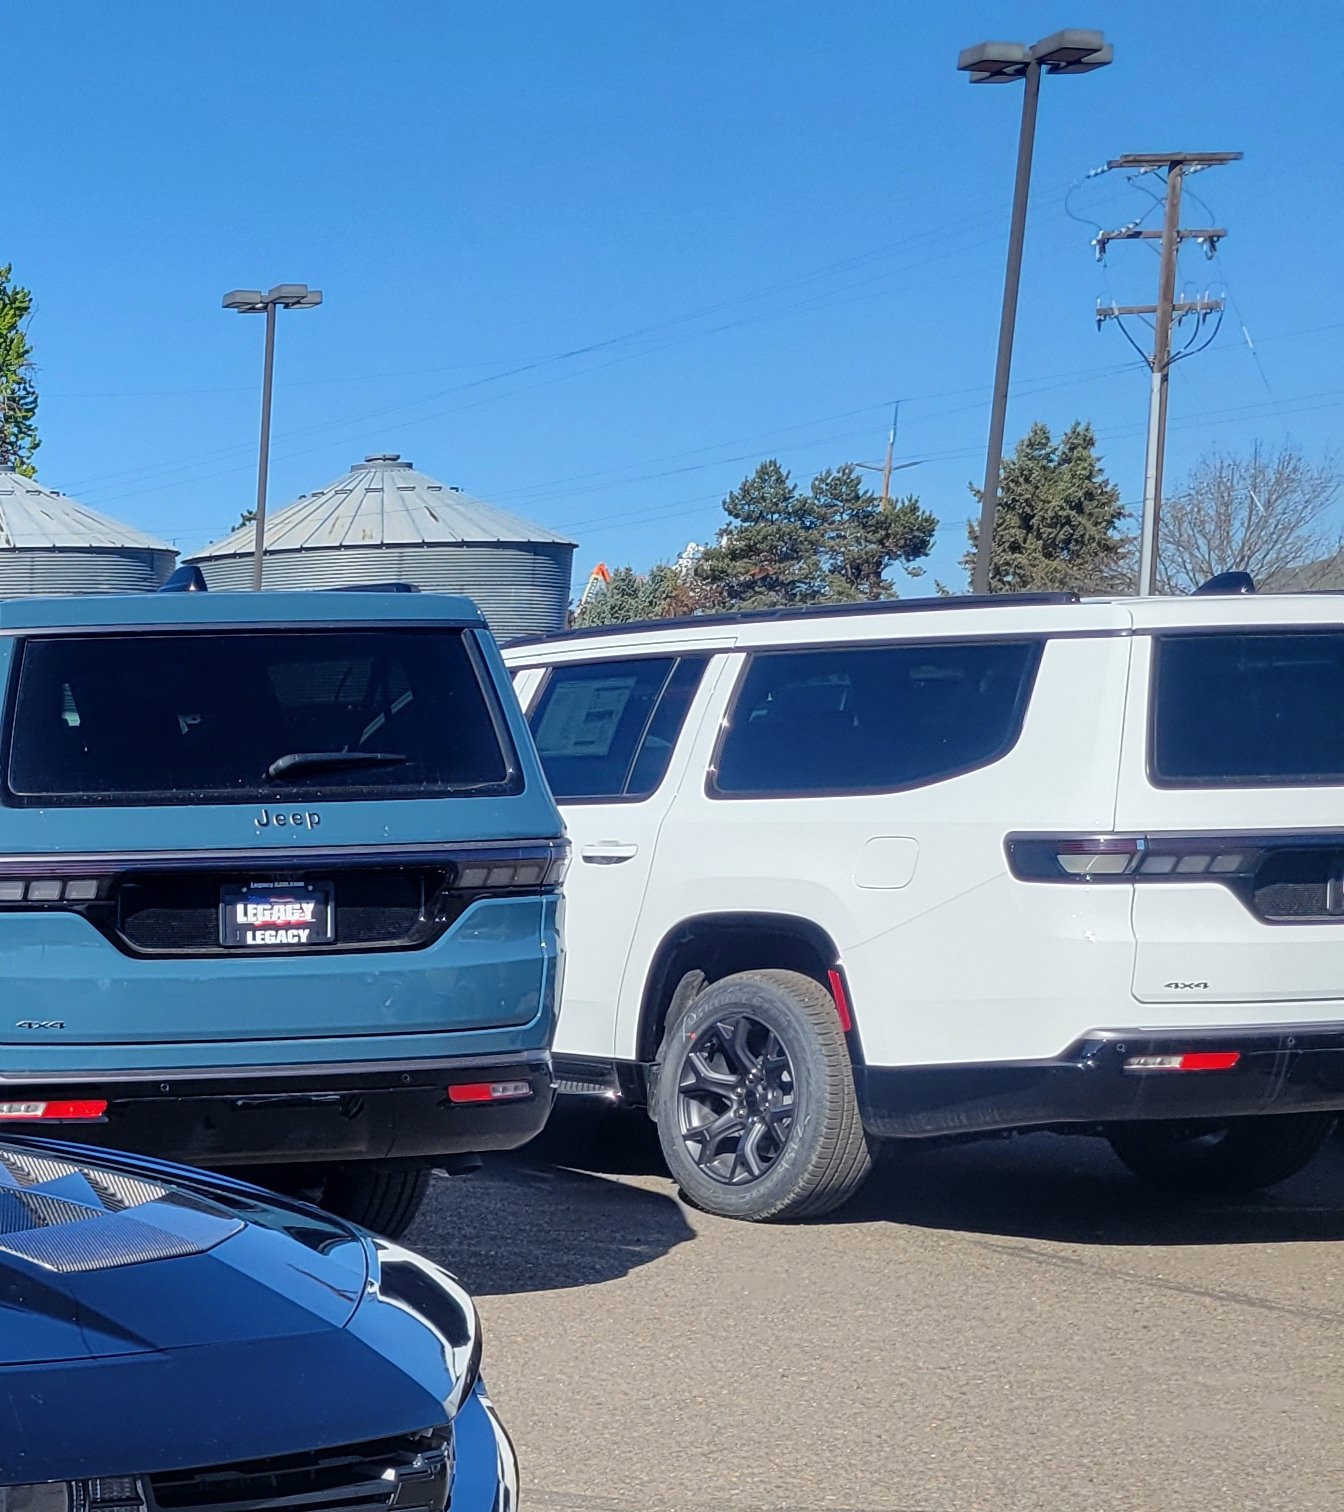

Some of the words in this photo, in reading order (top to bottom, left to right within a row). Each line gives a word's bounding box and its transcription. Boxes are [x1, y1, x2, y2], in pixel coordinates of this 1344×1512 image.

[254, 808, 321, 830] Jeep
[236, 902, 316, 922] LEGACY
[246, 929, 310, 944] LEGACY
